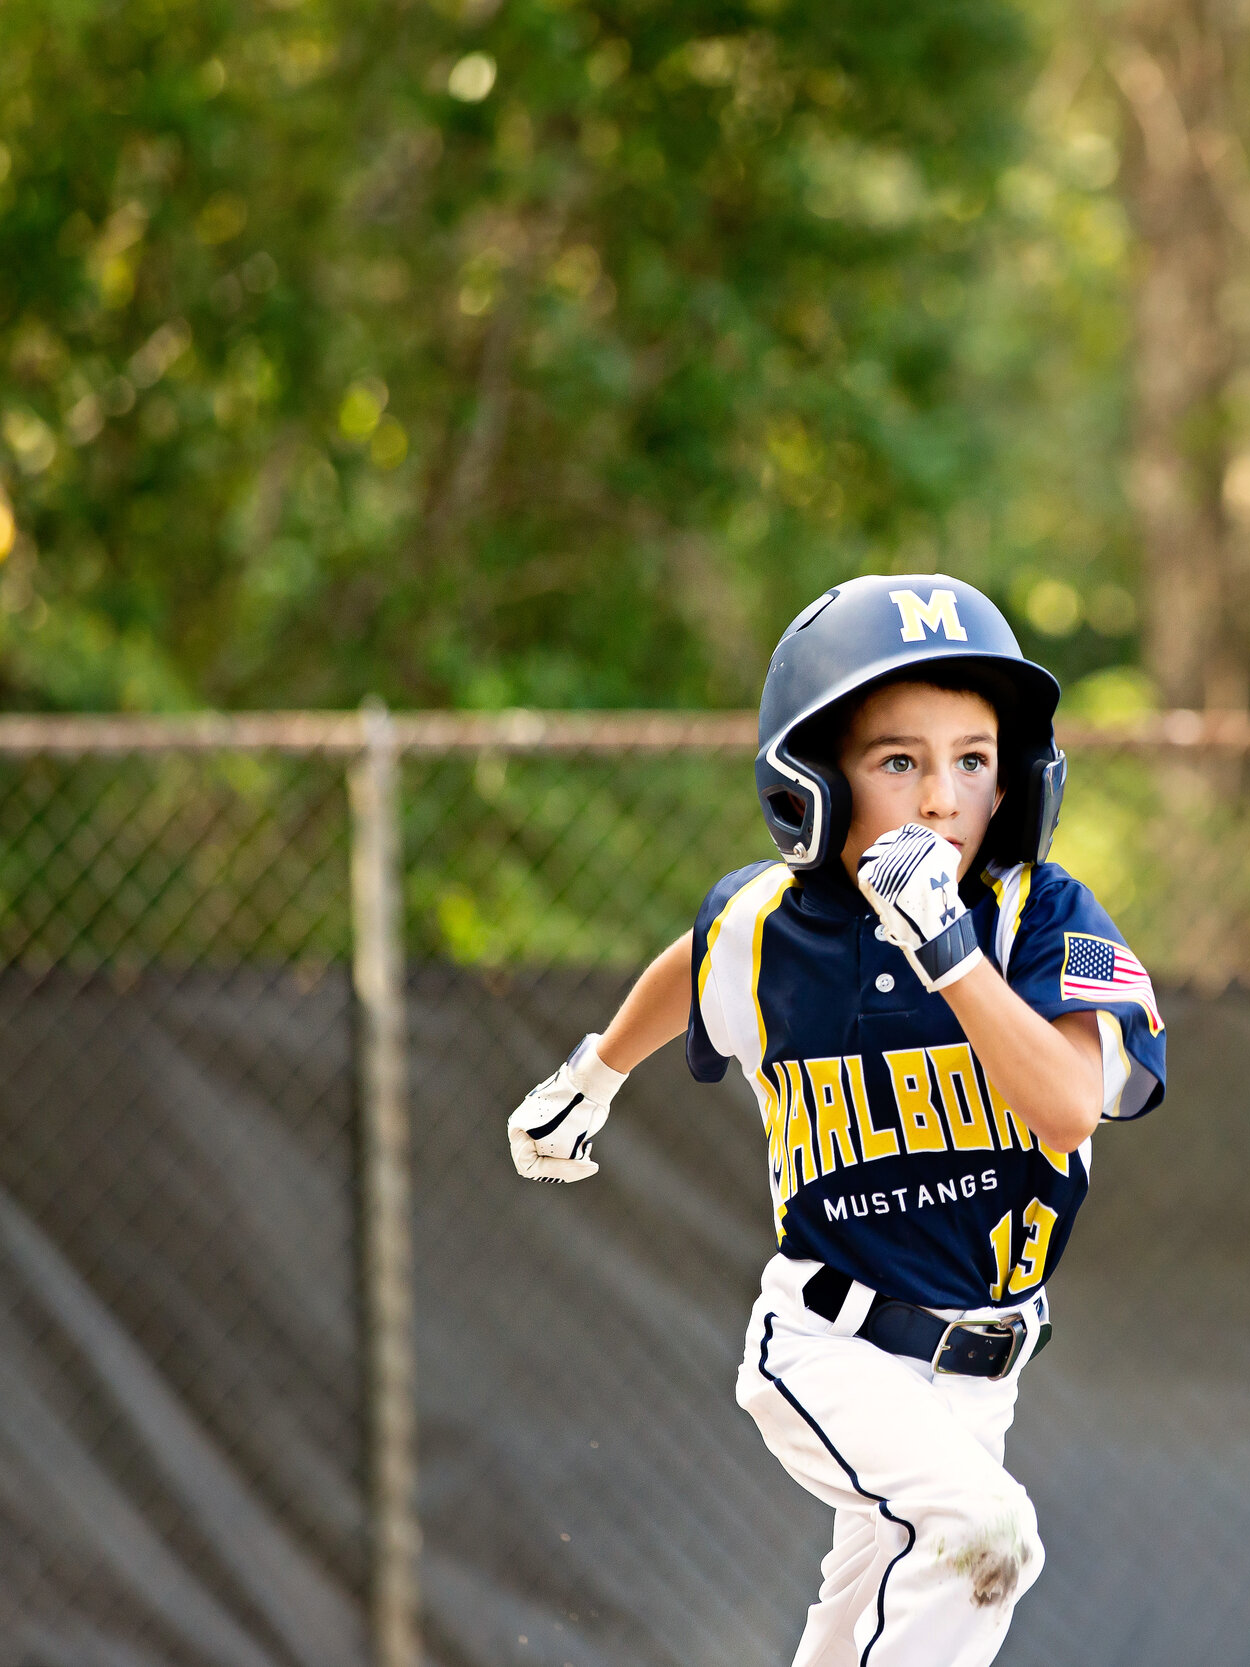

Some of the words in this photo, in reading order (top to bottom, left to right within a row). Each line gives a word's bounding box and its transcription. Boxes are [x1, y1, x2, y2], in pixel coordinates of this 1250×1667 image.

[889, 589, 968, 643] M
[767, 1042, 1069, 1200] MARLBO
[823, 1169, 998, 1222] MUSTANGS
[989, 1197, 1058, 1301] 13
